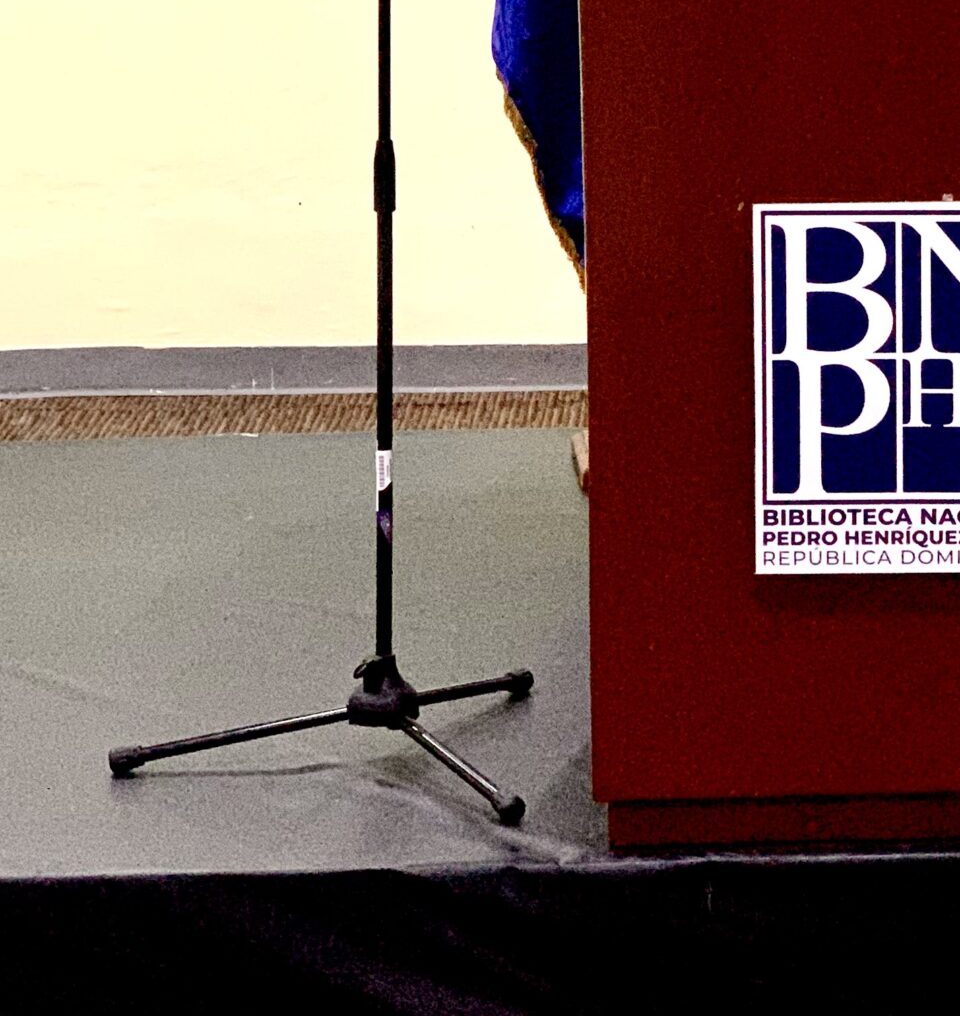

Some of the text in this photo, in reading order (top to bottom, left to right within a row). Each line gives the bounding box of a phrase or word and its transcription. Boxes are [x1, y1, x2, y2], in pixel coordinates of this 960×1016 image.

[763, 508, 913, 526] BIBLIOTECA
[763, 530, 838, 546] PEDRO
[763, 547, 892, 566] REPÚBLICA
